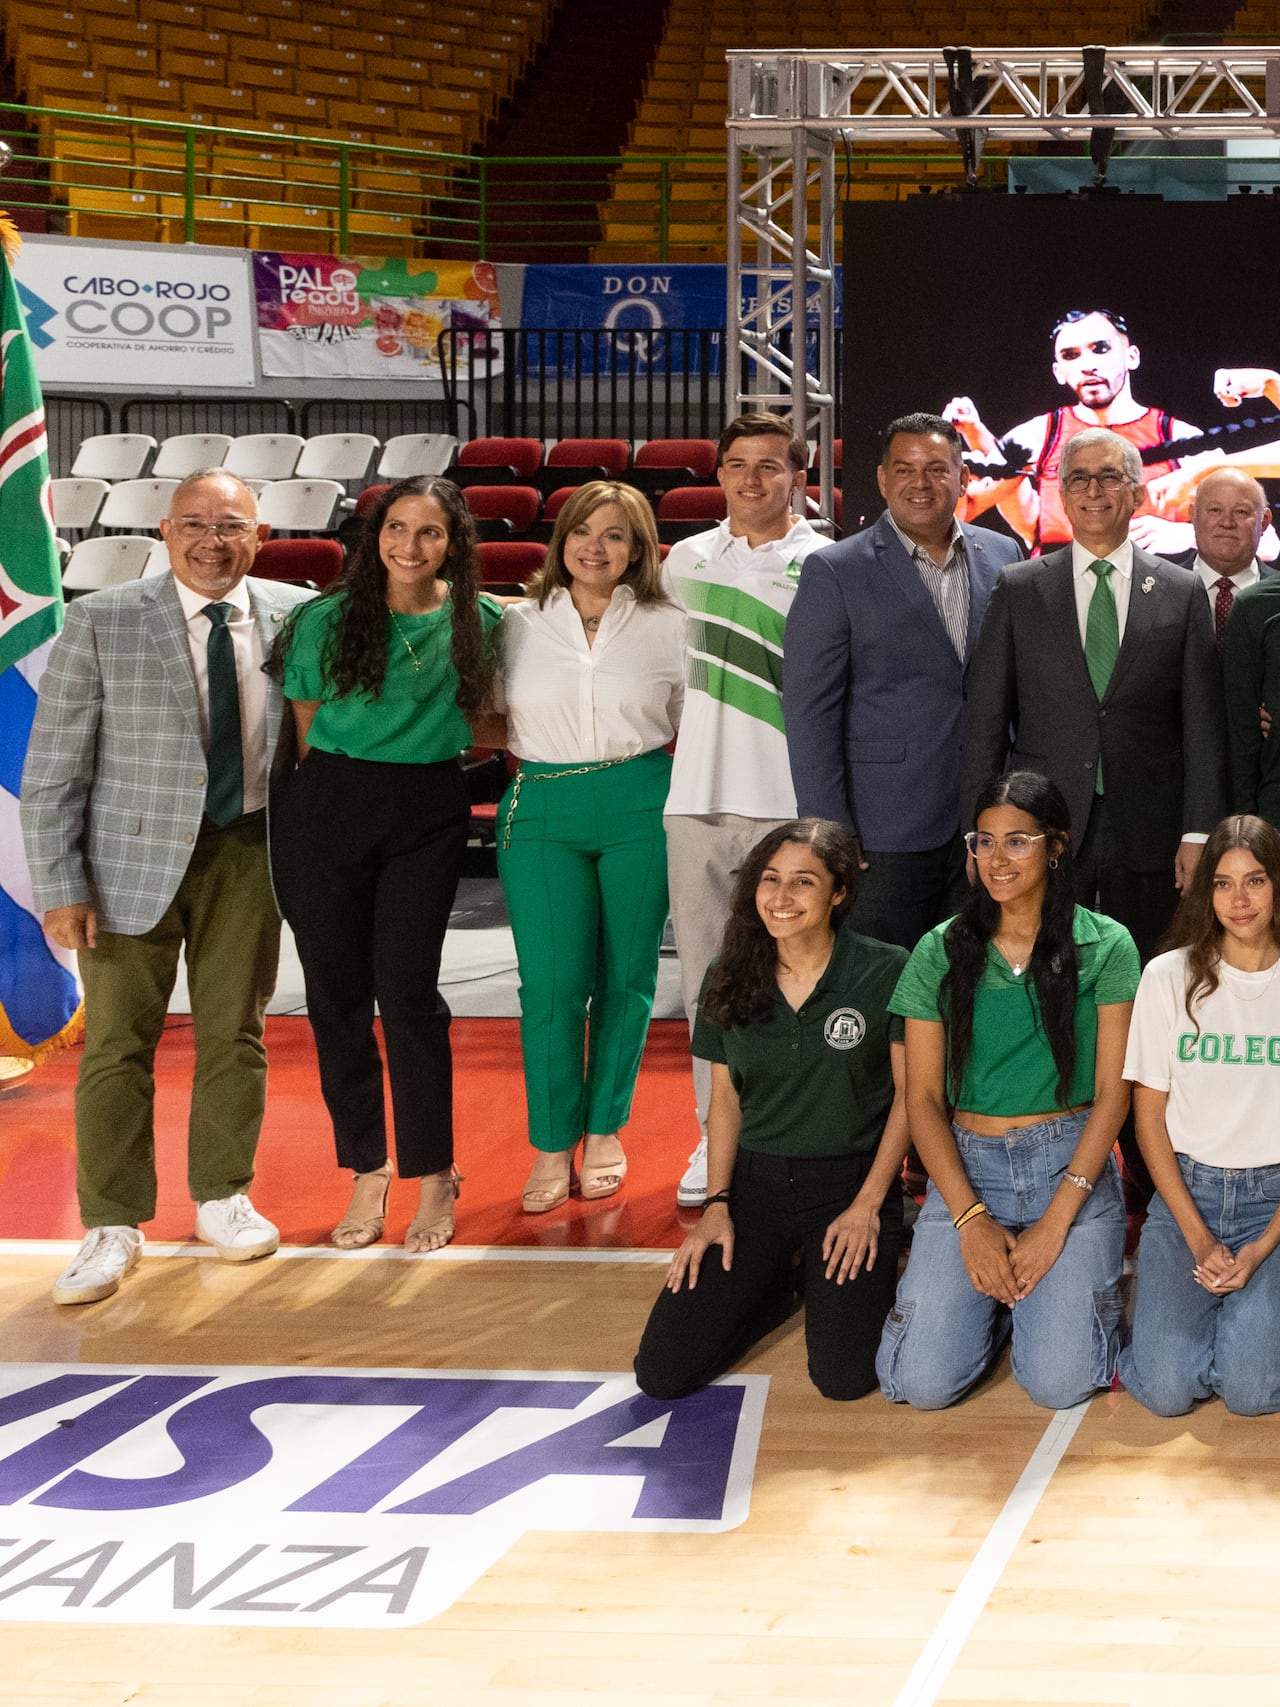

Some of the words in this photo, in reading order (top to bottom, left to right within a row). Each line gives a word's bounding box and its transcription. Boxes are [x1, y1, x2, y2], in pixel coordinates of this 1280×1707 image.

[63, 275, 139, 297] CABO
[156, 280, 230, 302] ROJO
[279, 265, 357, 292] PALO
[602, 275, 672, 295] DON
[280, 288, 360, 315] ready
[65, 299, 232, 338] COOP
[602, 297, 666, 363] Q
[66, 340, 132, 351] COOPERATIVA
[134, 344, 146, 352] DE
[148, 344, 188, 353] AHORRO
[189, 345, 197, 353] Y
[0, 1538, 431, 1614] IANZA
